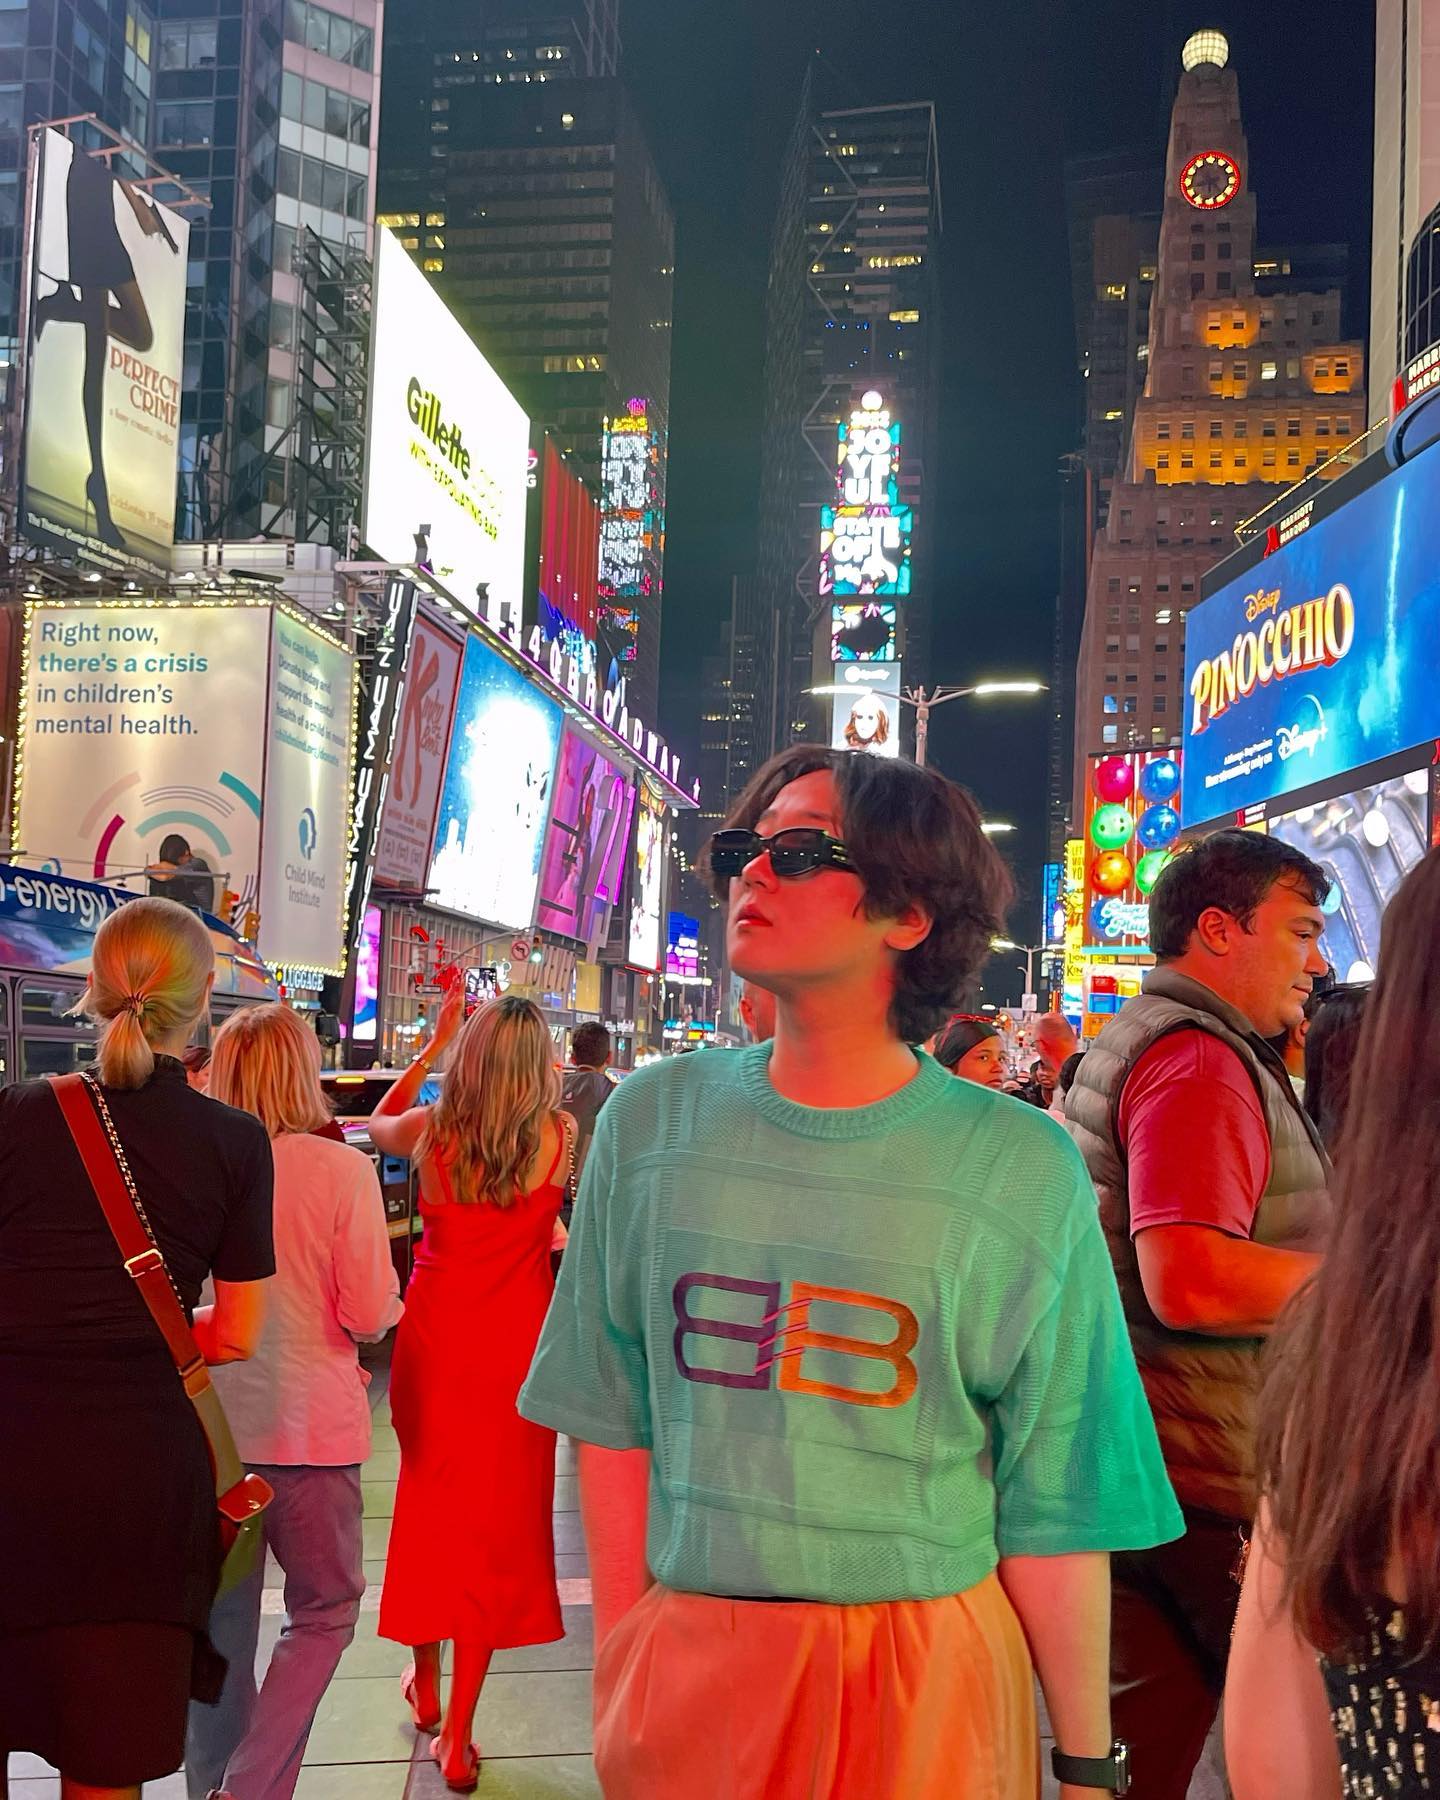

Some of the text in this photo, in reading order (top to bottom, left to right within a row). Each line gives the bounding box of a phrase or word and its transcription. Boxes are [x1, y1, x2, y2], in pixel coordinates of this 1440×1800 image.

[110, 346, 179, 404] PERFECT
[130, 383, 178, 429] CRIME
[407, 376, 471, 480] Gillette
[1243, 588, 1281, 622] Disney
[41, 622, 159, 647] Right now,
[38, 653, 209, 673] there's a crisis
[278, 654, 301, 679] Donate
[302, 668, 320, 691] today
[1190, 583, 1355, 736] PINOCCHIO
[36, 683, 174, 704] in children's
[277, 681, 302, 703] support
[303, 691, 313, 708] the
[35, 714, 199, 735] mental health.
[364, 675, 389, 759] MAC
[568, 655, 681, 784] BROADWAY
[350, 767, 373, 853] MAC
[285, 863, 307, 883] Child
[307, 869, 326, 890] Mind
[288, 885, 321, 908] Institute
[282, 969, 325, 992] LUGGAGE
[1067, 964, 1083, 977] KIN
